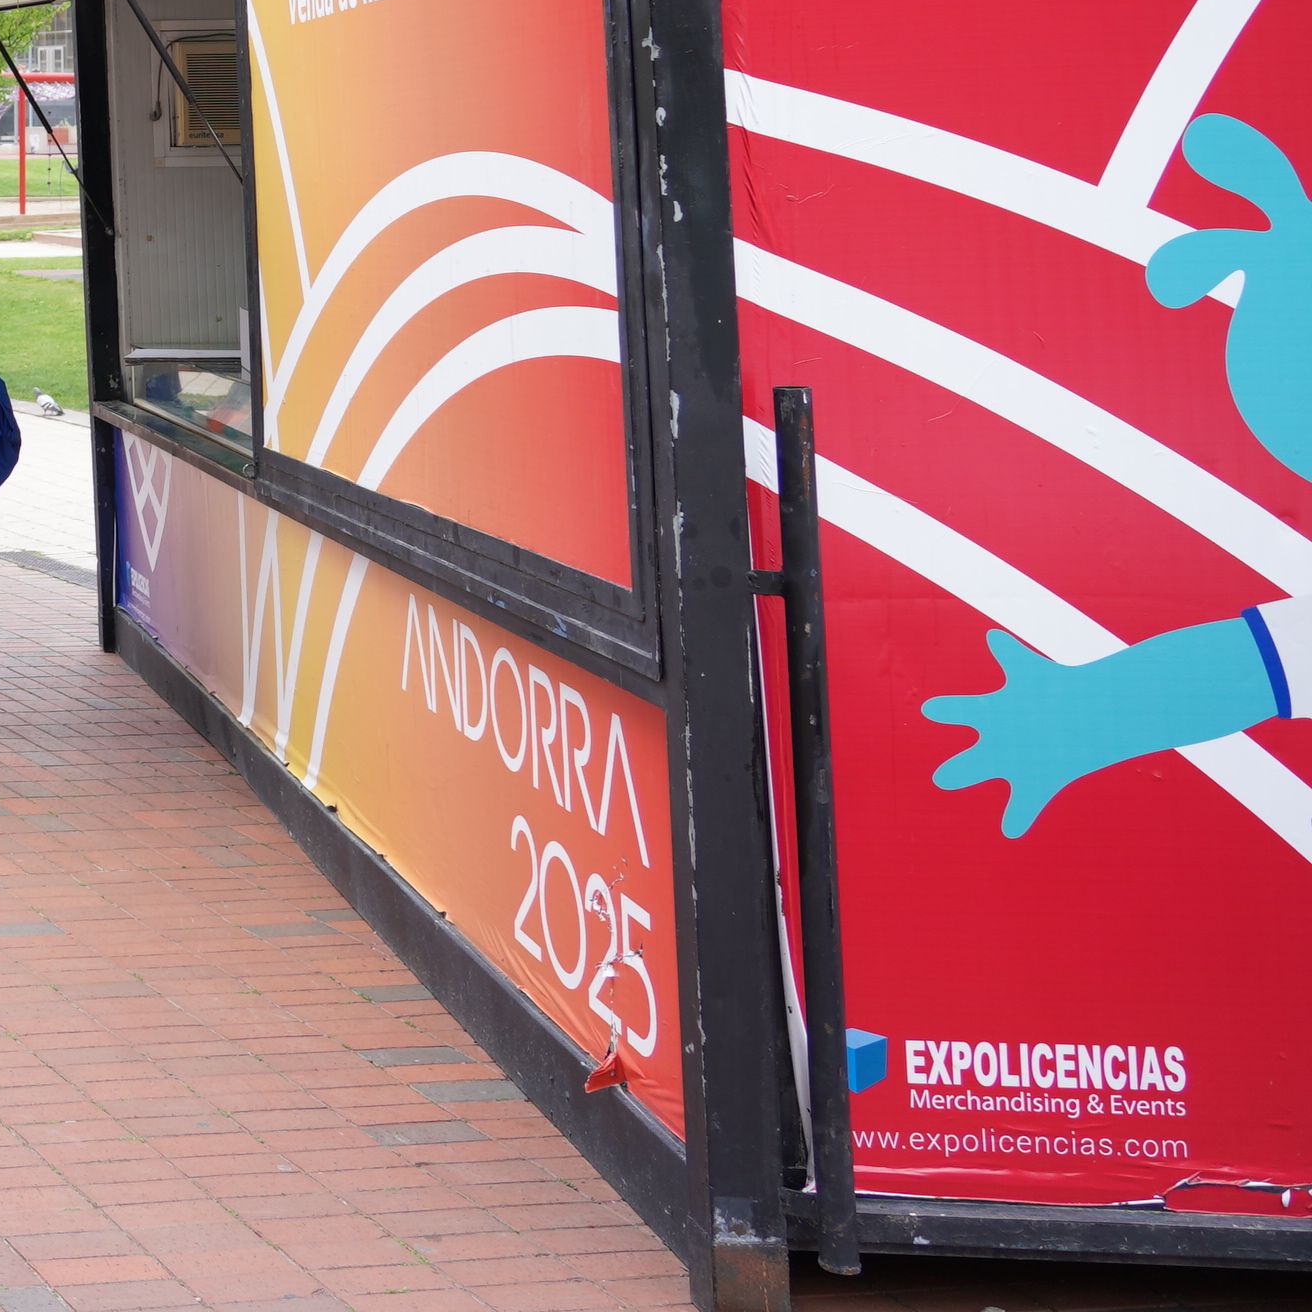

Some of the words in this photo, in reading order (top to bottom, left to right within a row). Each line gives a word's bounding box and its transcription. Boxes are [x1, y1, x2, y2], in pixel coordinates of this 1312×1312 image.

[401, 593, 651, 869] ANDORRA
[510, 815, 658, 1058] 2025
[904, 1040, 1187, 1092] EXPOLICENCIAS
[909, 1089, 1079, 1119] Merchandising
[1089, 1095, 1105, 1114] &
[1111, 1095, 1187, 1117] Events
[852, 1127, 1189, 1159] ww.expolicencias.com
